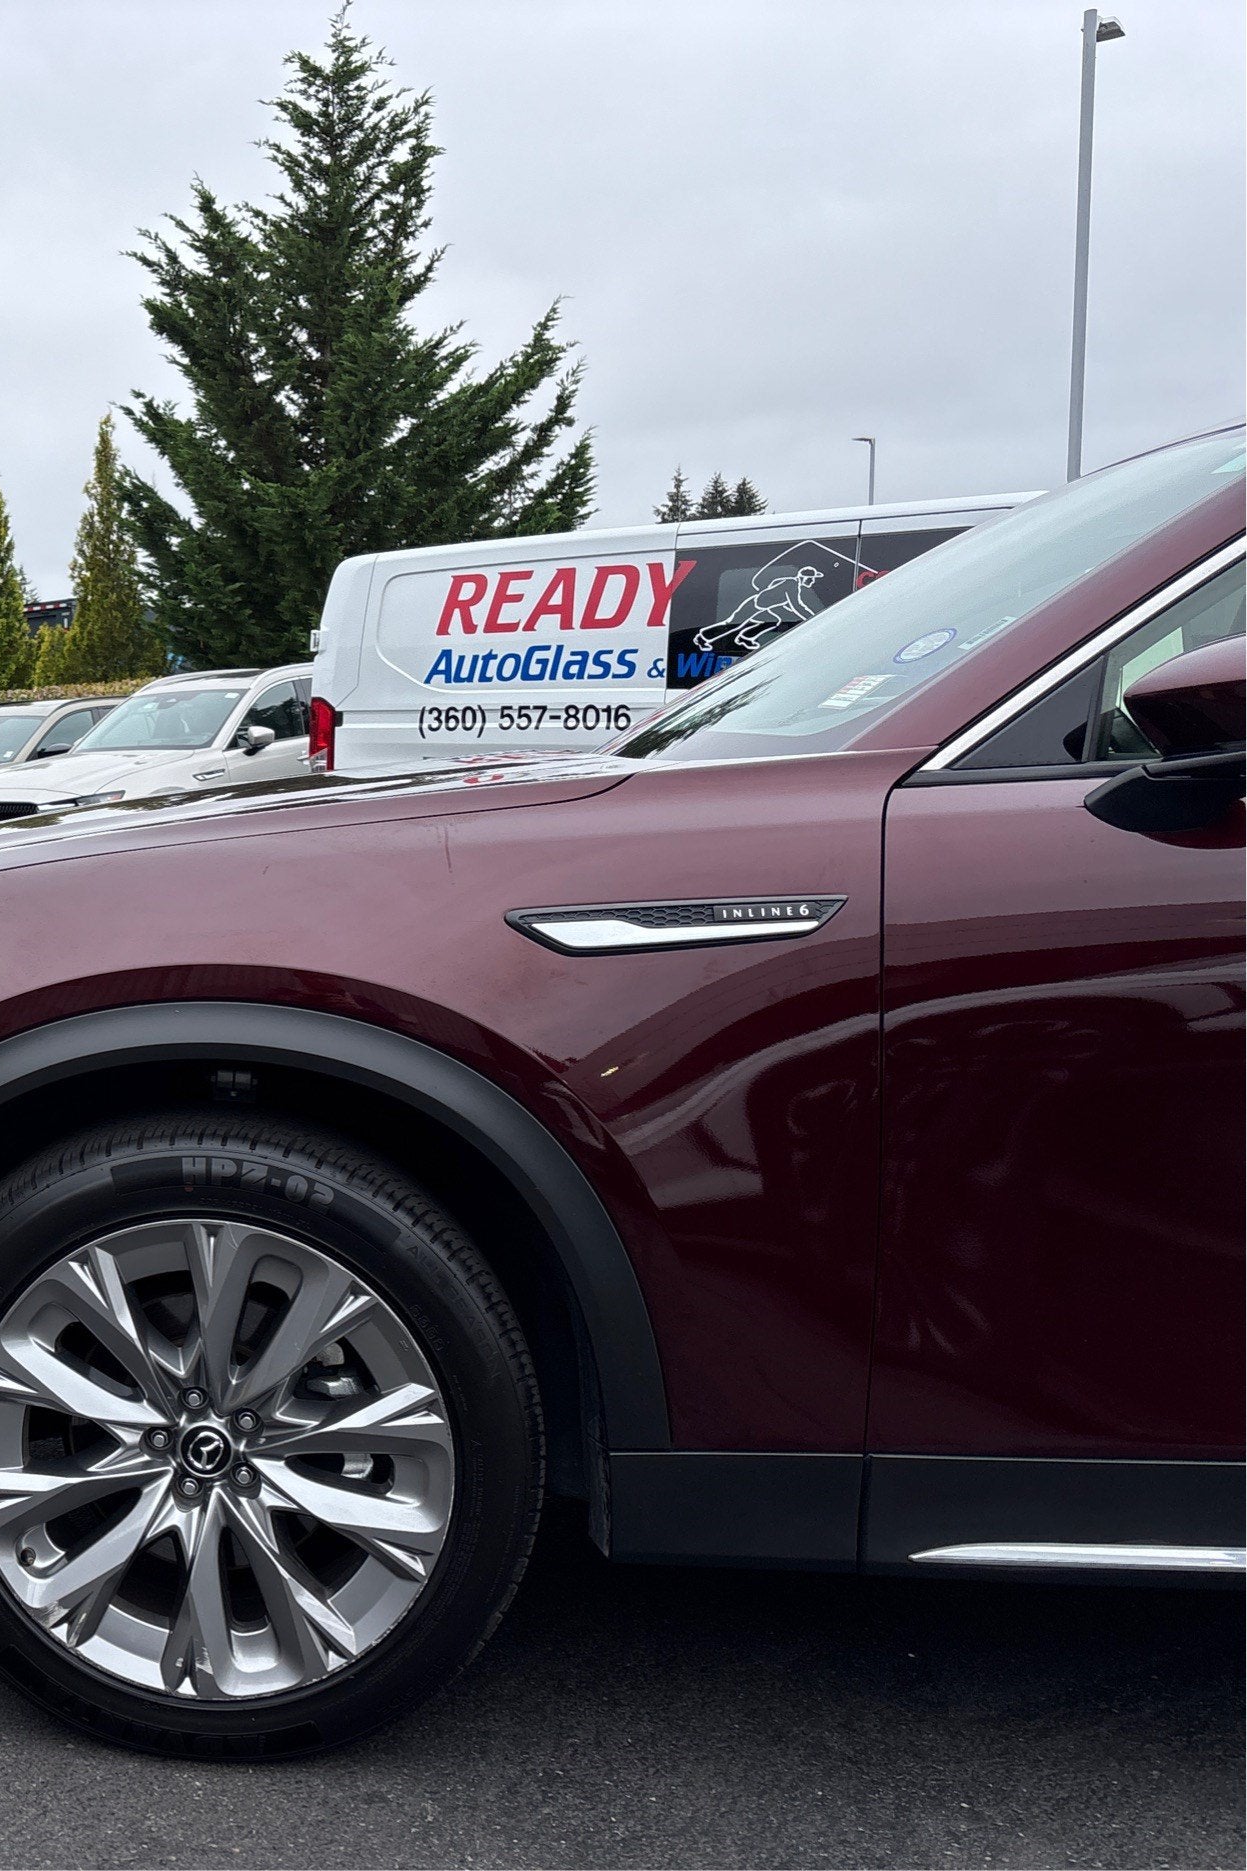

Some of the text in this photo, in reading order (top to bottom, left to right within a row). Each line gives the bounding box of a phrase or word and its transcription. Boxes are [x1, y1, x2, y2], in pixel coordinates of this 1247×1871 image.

[436, 560, 697, 636] READY
[424, 645, 639, 685] AutoGlass
[647, 657, 666, 679] &
[418, 704, 632, 739] (360) 557-8016
